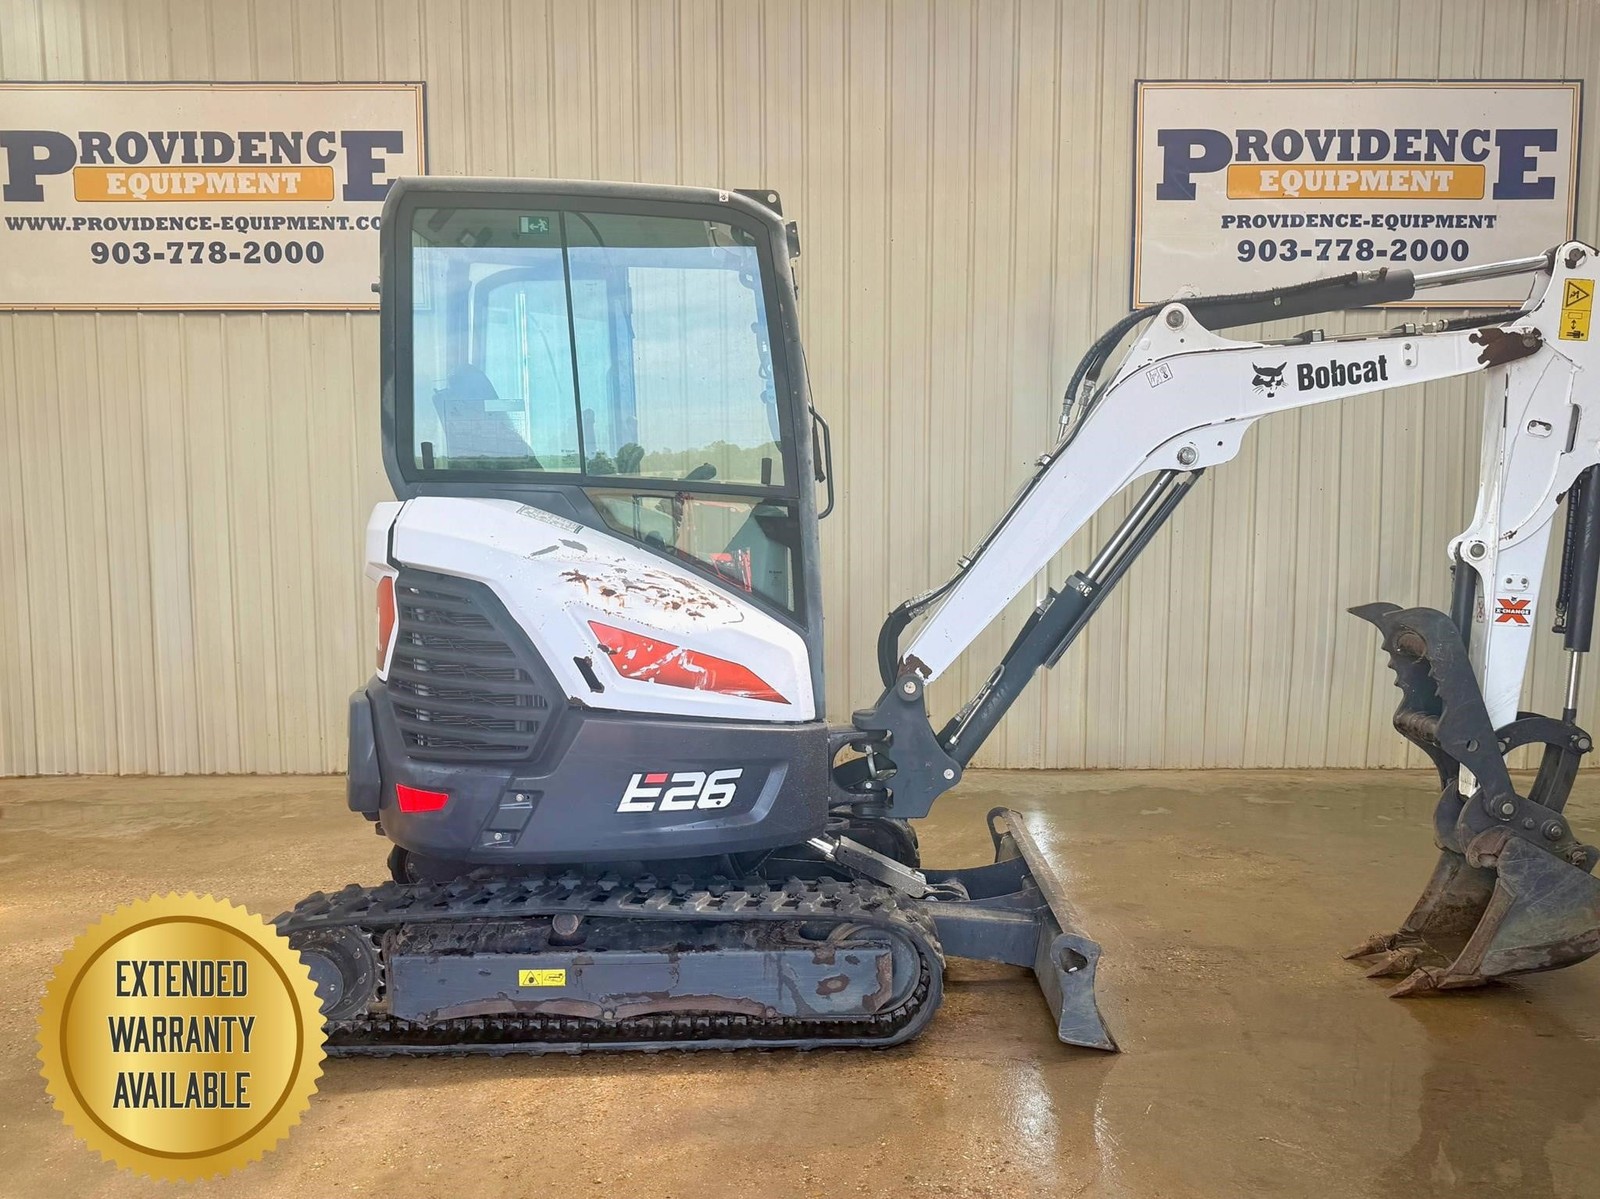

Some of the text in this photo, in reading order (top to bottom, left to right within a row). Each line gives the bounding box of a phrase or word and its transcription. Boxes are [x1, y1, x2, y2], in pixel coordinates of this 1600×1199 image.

[0, 131, 403, 202] PROVIDENCE
[1156, 129, 1558, 200] PROVIDENCE
[107, 172, 301, 200] EQUIPMENT
[1259, 169, 1454, 197] EQUIPMENT
[1221, 214, 1497, 232] PROVIDENCE-EQUIPMENT
[91, 241, 324, 265] 903-778-2000
[1237, 239, 1469, 262] 903-778-2000
[1296, 354, 1388, 392] Bobcat
[616, 768, 744, 813] E26
